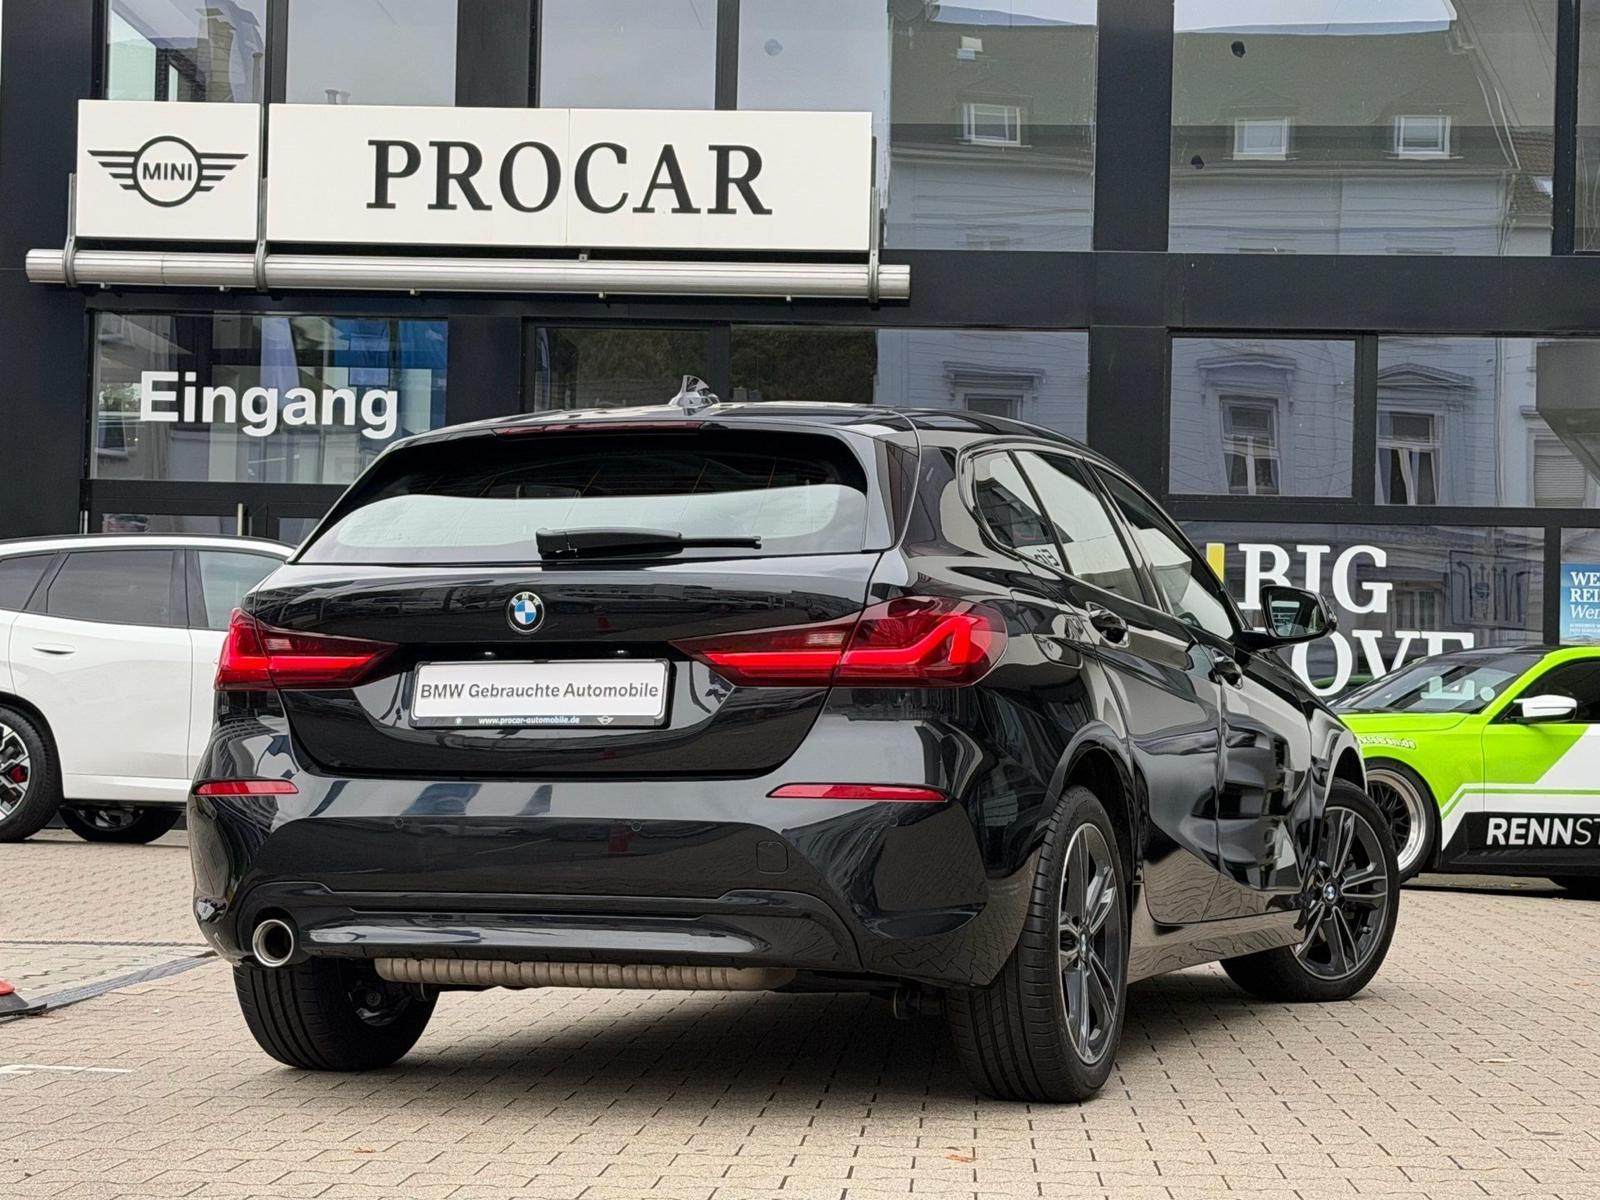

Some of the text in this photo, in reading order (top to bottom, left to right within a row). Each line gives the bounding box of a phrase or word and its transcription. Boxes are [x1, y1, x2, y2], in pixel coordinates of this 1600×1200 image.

[142, 162, 193, 182] MINI
[366, 139, 773, 215] PROCAR
[140, 370, 398, 440] Eingang
[1237, 543, 1393, 614] BIG
[420, 682, 659, 699] BMW Gebrauchte Automobile
[478, 715, 580, 726] www.procar-automobile.de
